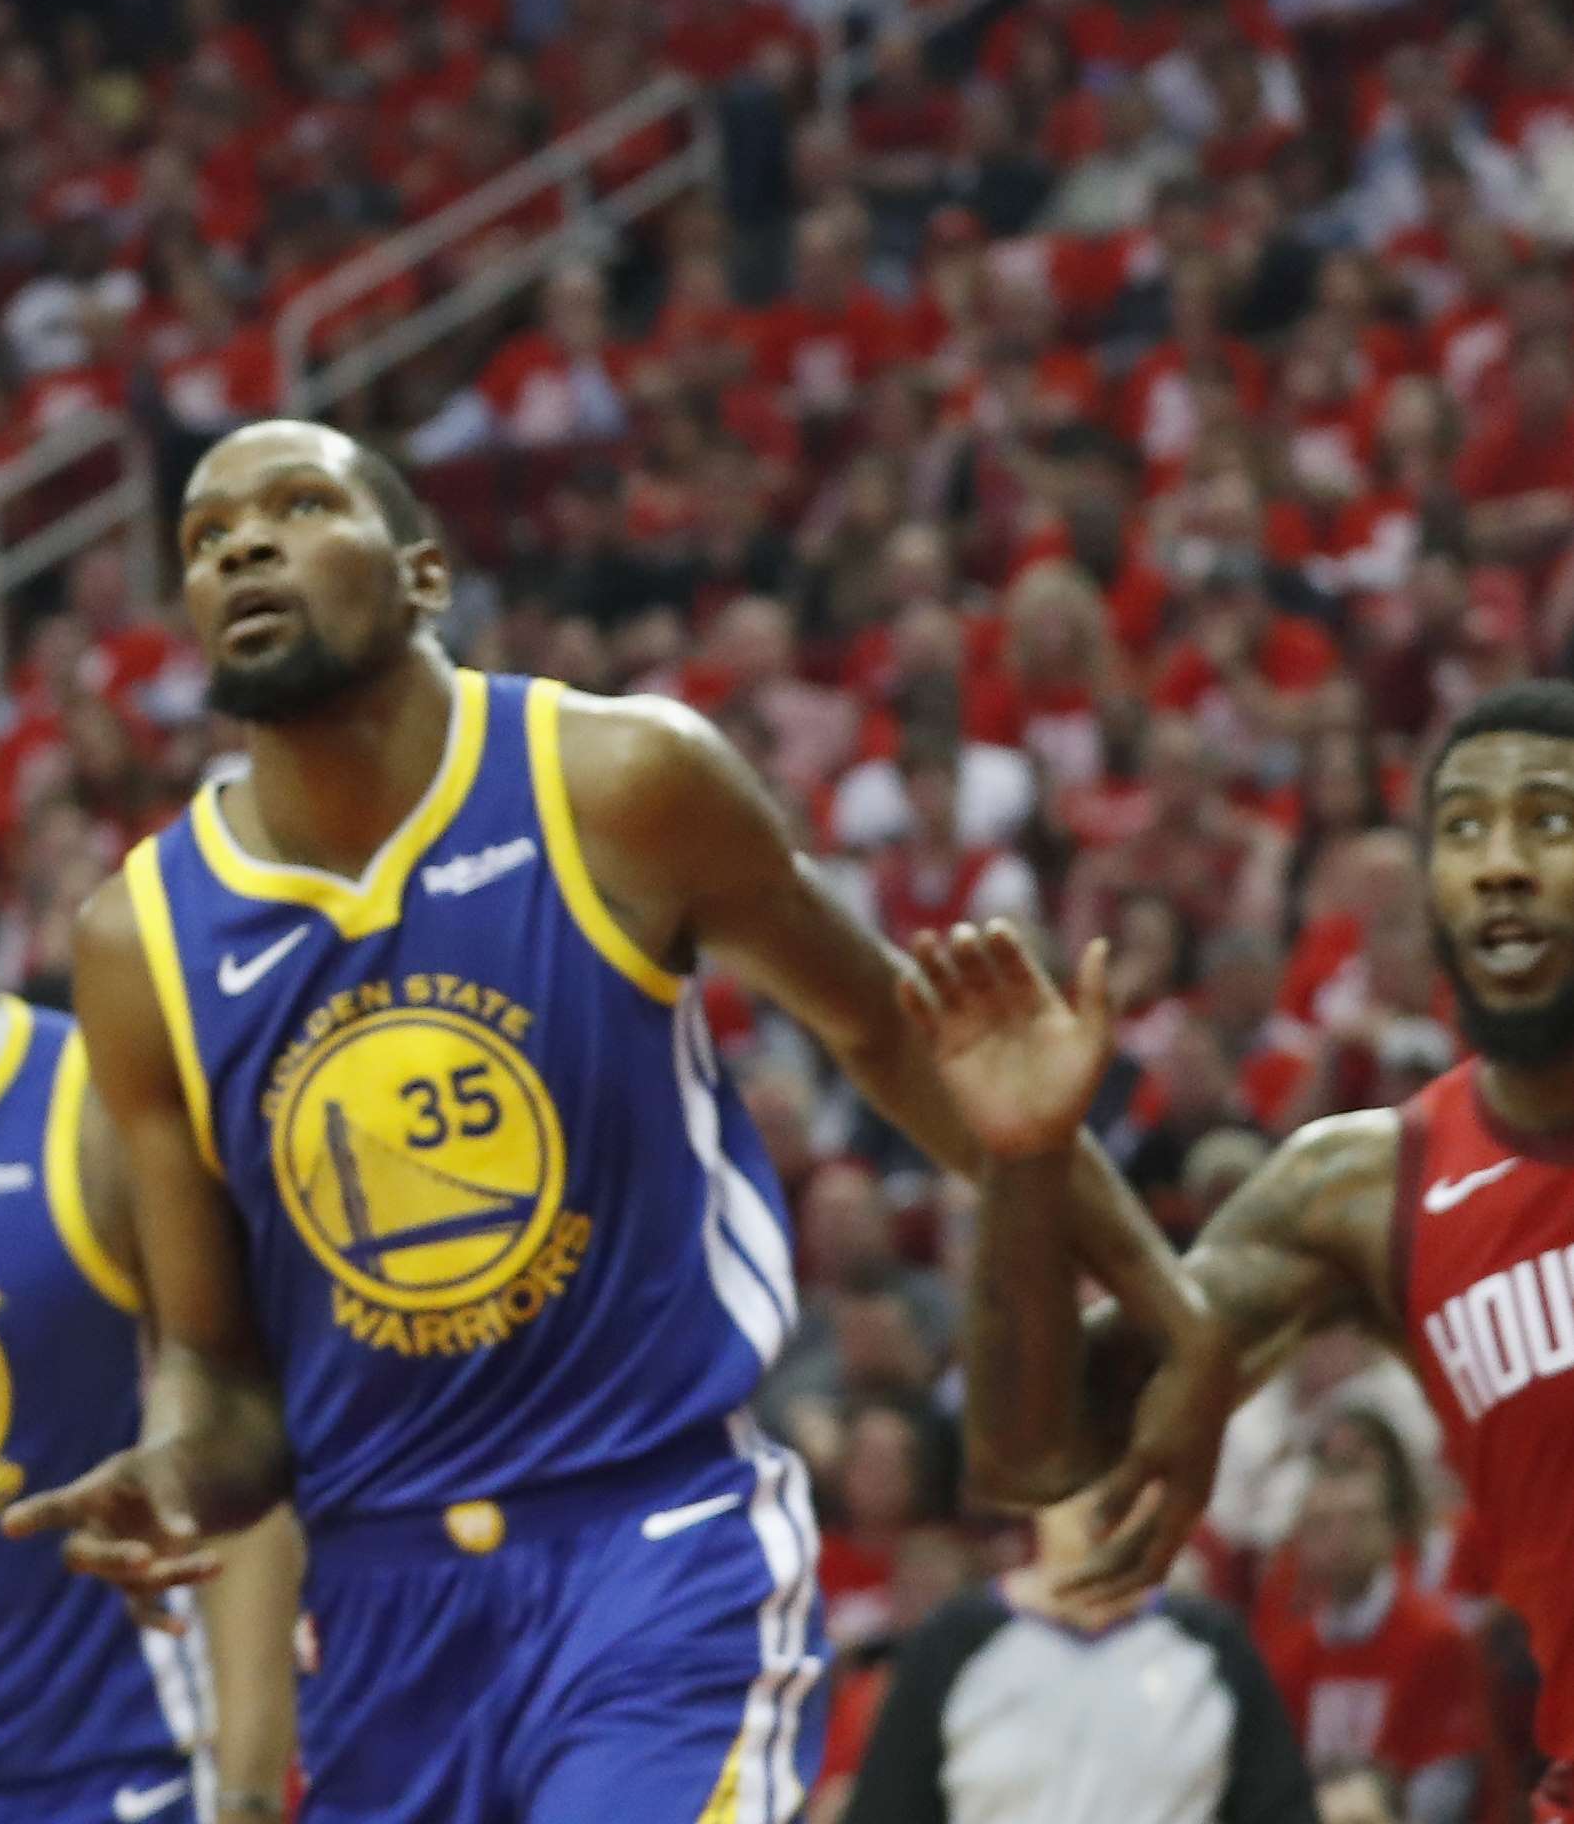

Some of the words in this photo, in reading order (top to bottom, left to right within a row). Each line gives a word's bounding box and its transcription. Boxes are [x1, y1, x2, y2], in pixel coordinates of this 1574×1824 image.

[404, 974, 536, 1038] STATE
[398, 1061, 505, 1151] 35
[331, 1210, 593, 1357] WARRIORS
[1424, 1242, 1574, 1424] HOU
